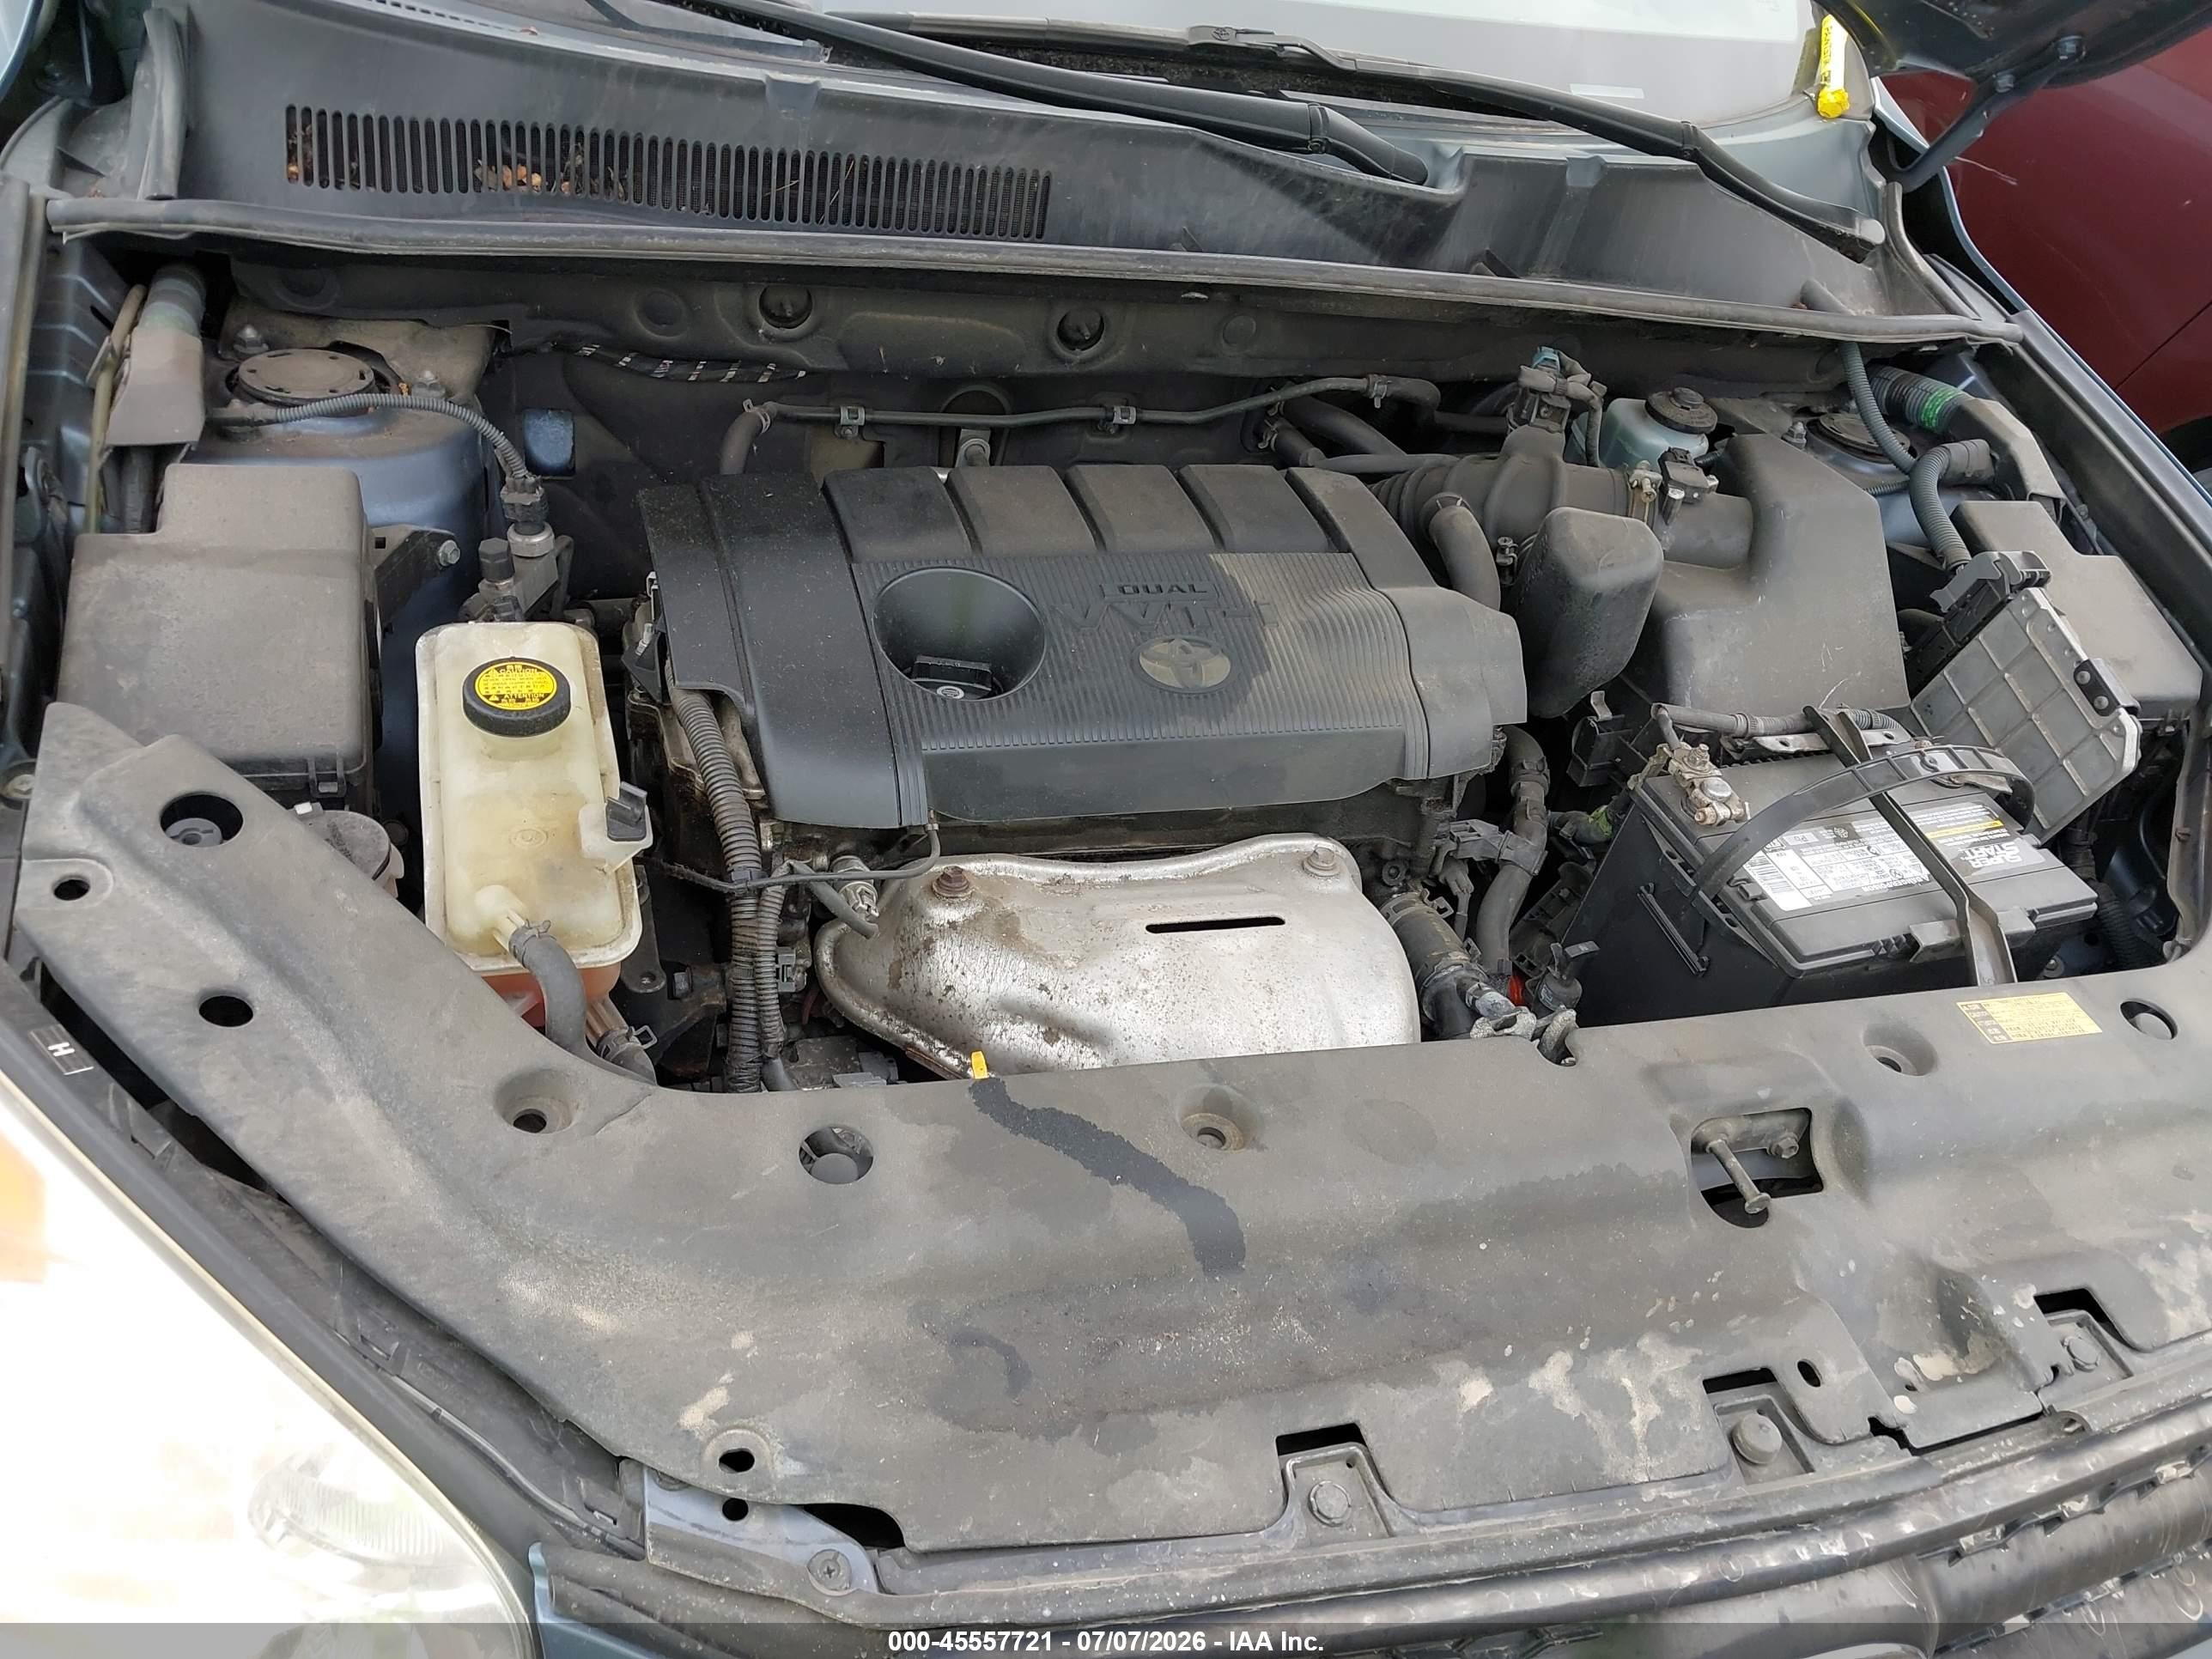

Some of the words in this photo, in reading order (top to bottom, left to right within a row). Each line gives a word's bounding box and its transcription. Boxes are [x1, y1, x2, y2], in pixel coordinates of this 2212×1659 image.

[1118, 584, 1207, 594] DUAL
[1965, 842, 2021, 860] START
[1969, 854, 2023, 869] SUPER
